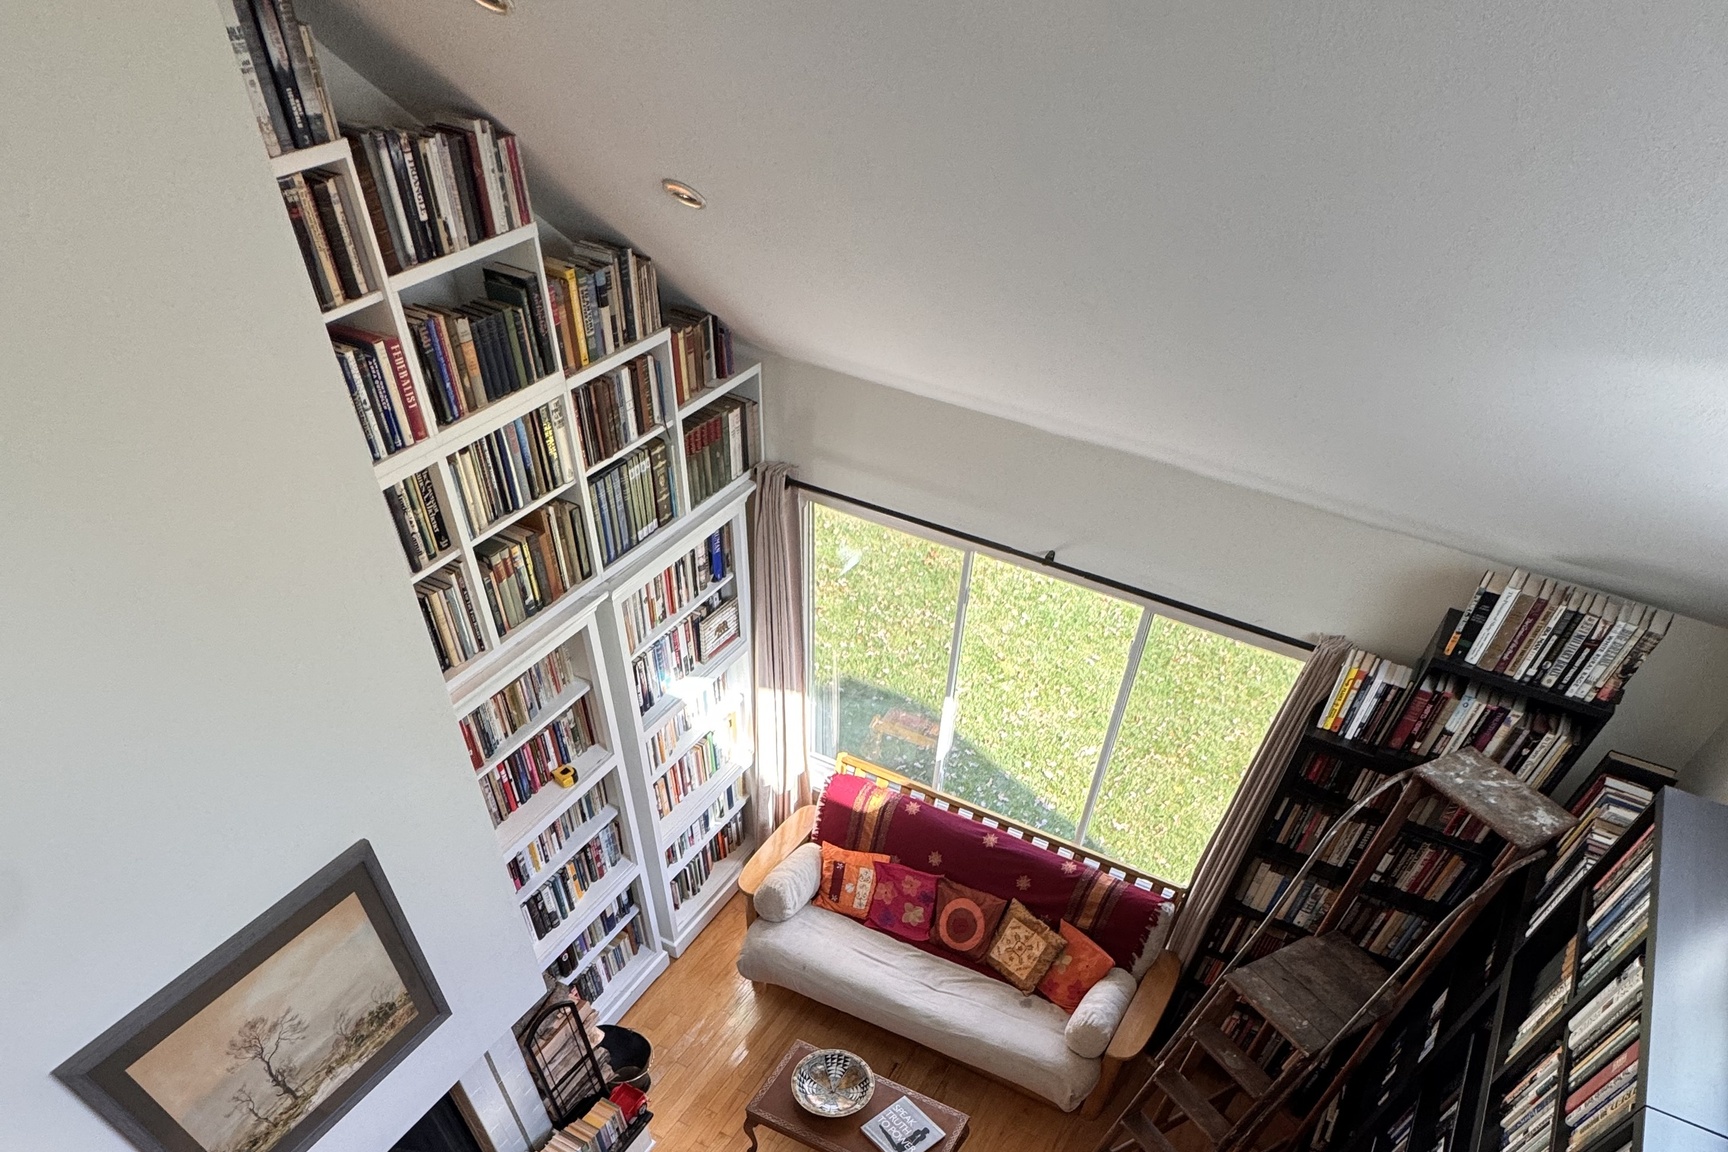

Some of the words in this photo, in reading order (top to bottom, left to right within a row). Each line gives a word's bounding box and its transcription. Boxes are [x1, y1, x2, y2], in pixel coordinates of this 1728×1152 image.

[405, 157, 426, 215] TRIANGLE
[585, 301, 594, 331] ANYONE
[390, 344, 416, 409] FEDERALIST
[352, 391, 373, 438] Watershed
[1598, 636, 1612, 651] WHITE
[1584, 653, 1599, 670] RURAL
[1573, 672, 1585, 687] RAGE
[884, 1109, 912, 1135] TRUTH
[892, 1104, 917, 1125] SPEAK
[877, 1115, 890, 1128] TO
[887, 1126, 916, 1152] POWER
